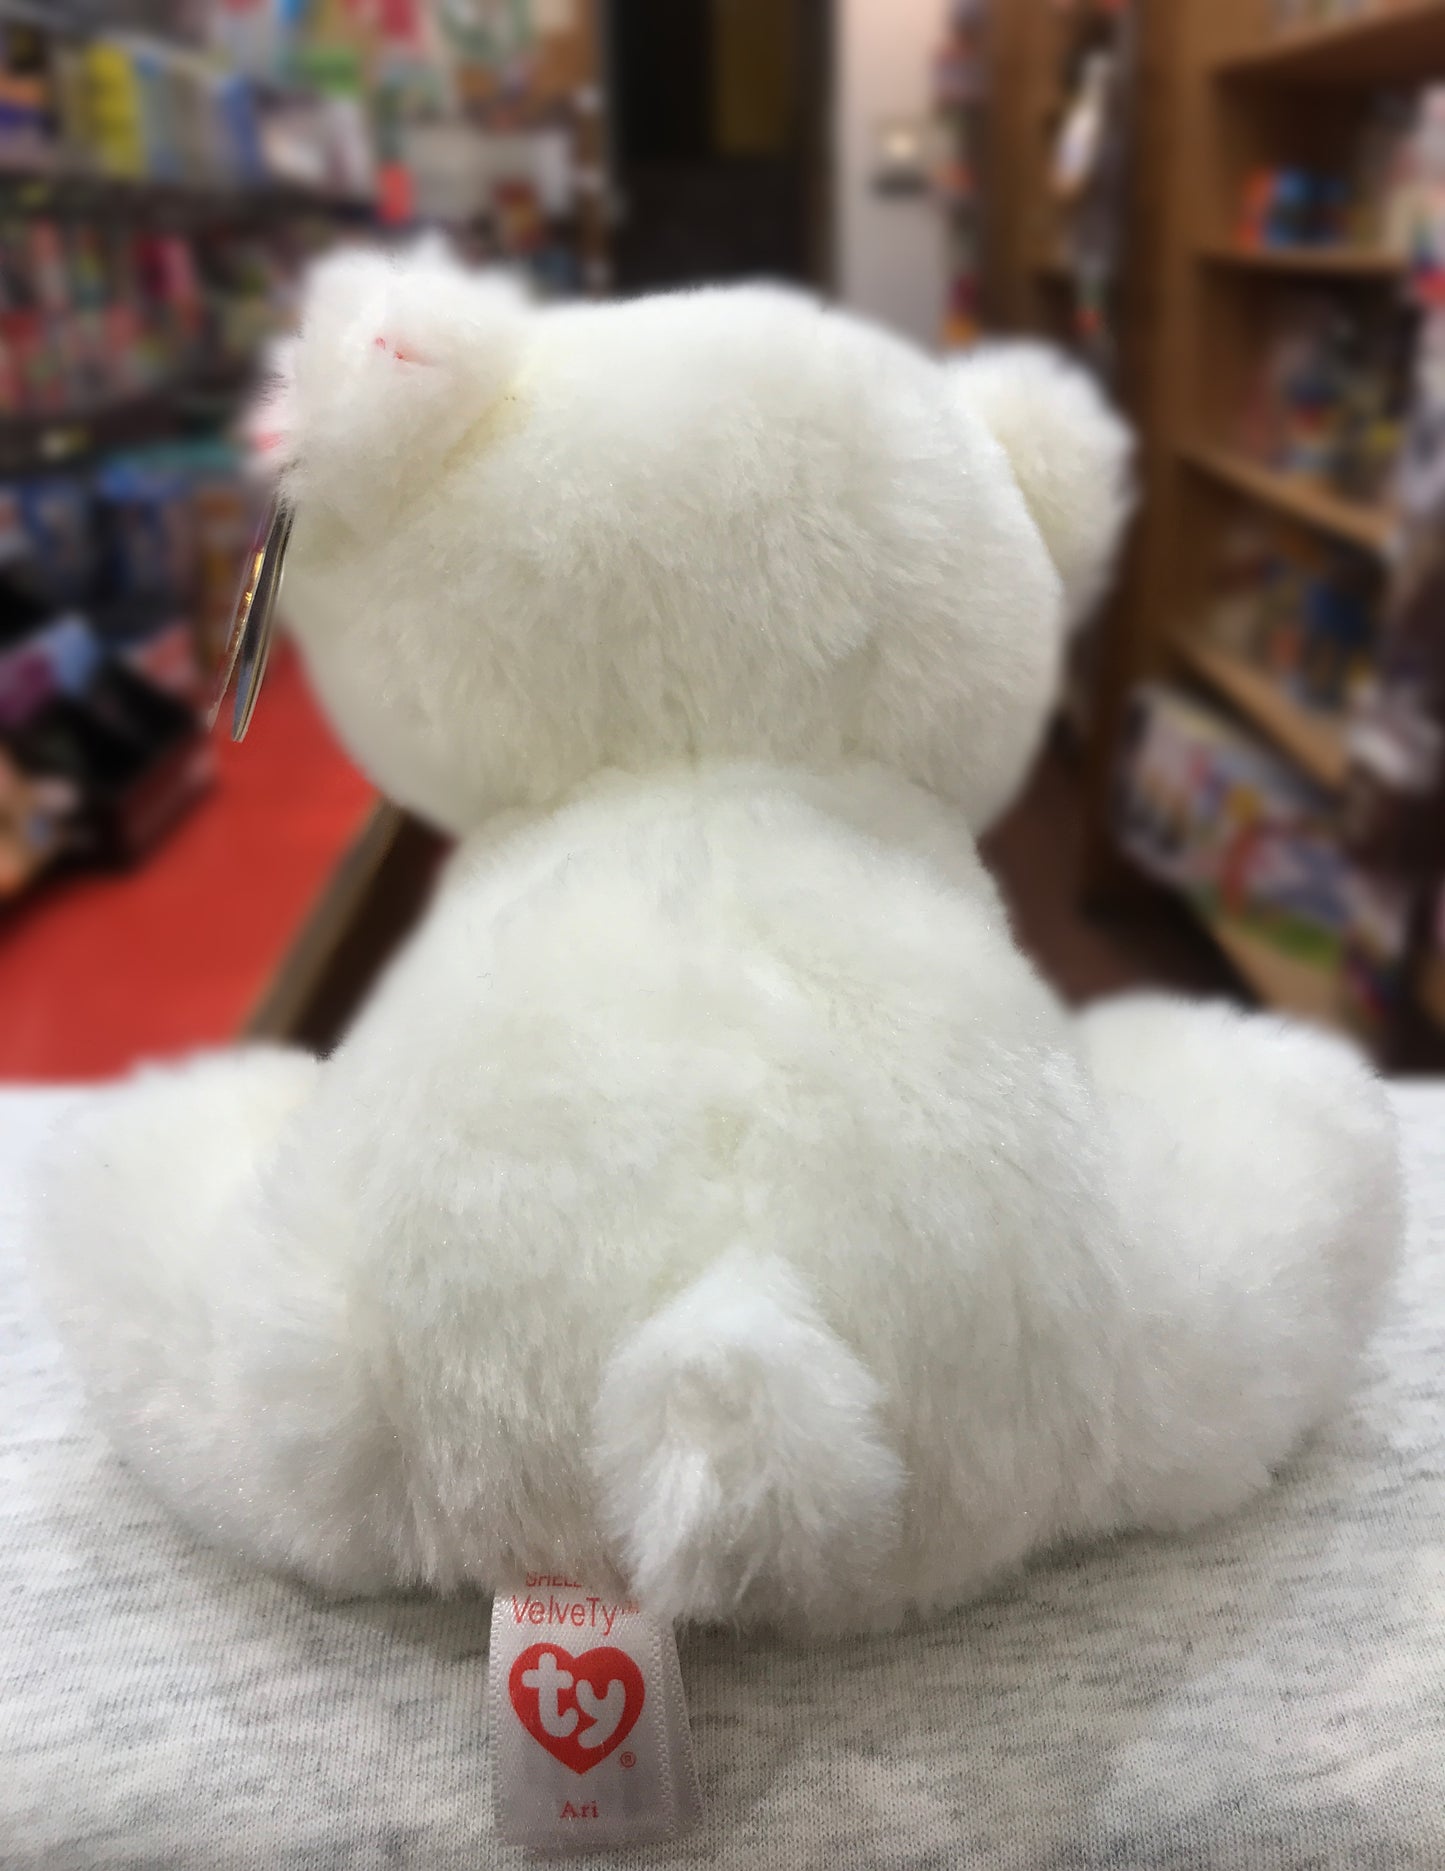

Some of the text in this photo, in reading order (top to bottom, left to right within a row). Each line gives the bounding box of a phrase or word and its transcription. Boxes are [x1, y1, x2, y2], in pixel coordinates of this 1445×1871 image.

[512, 1594, 618, 1636] VelveTy
[521, 1652, 627, 1749] ty
[559, 1801, 599, 1818] Ari
